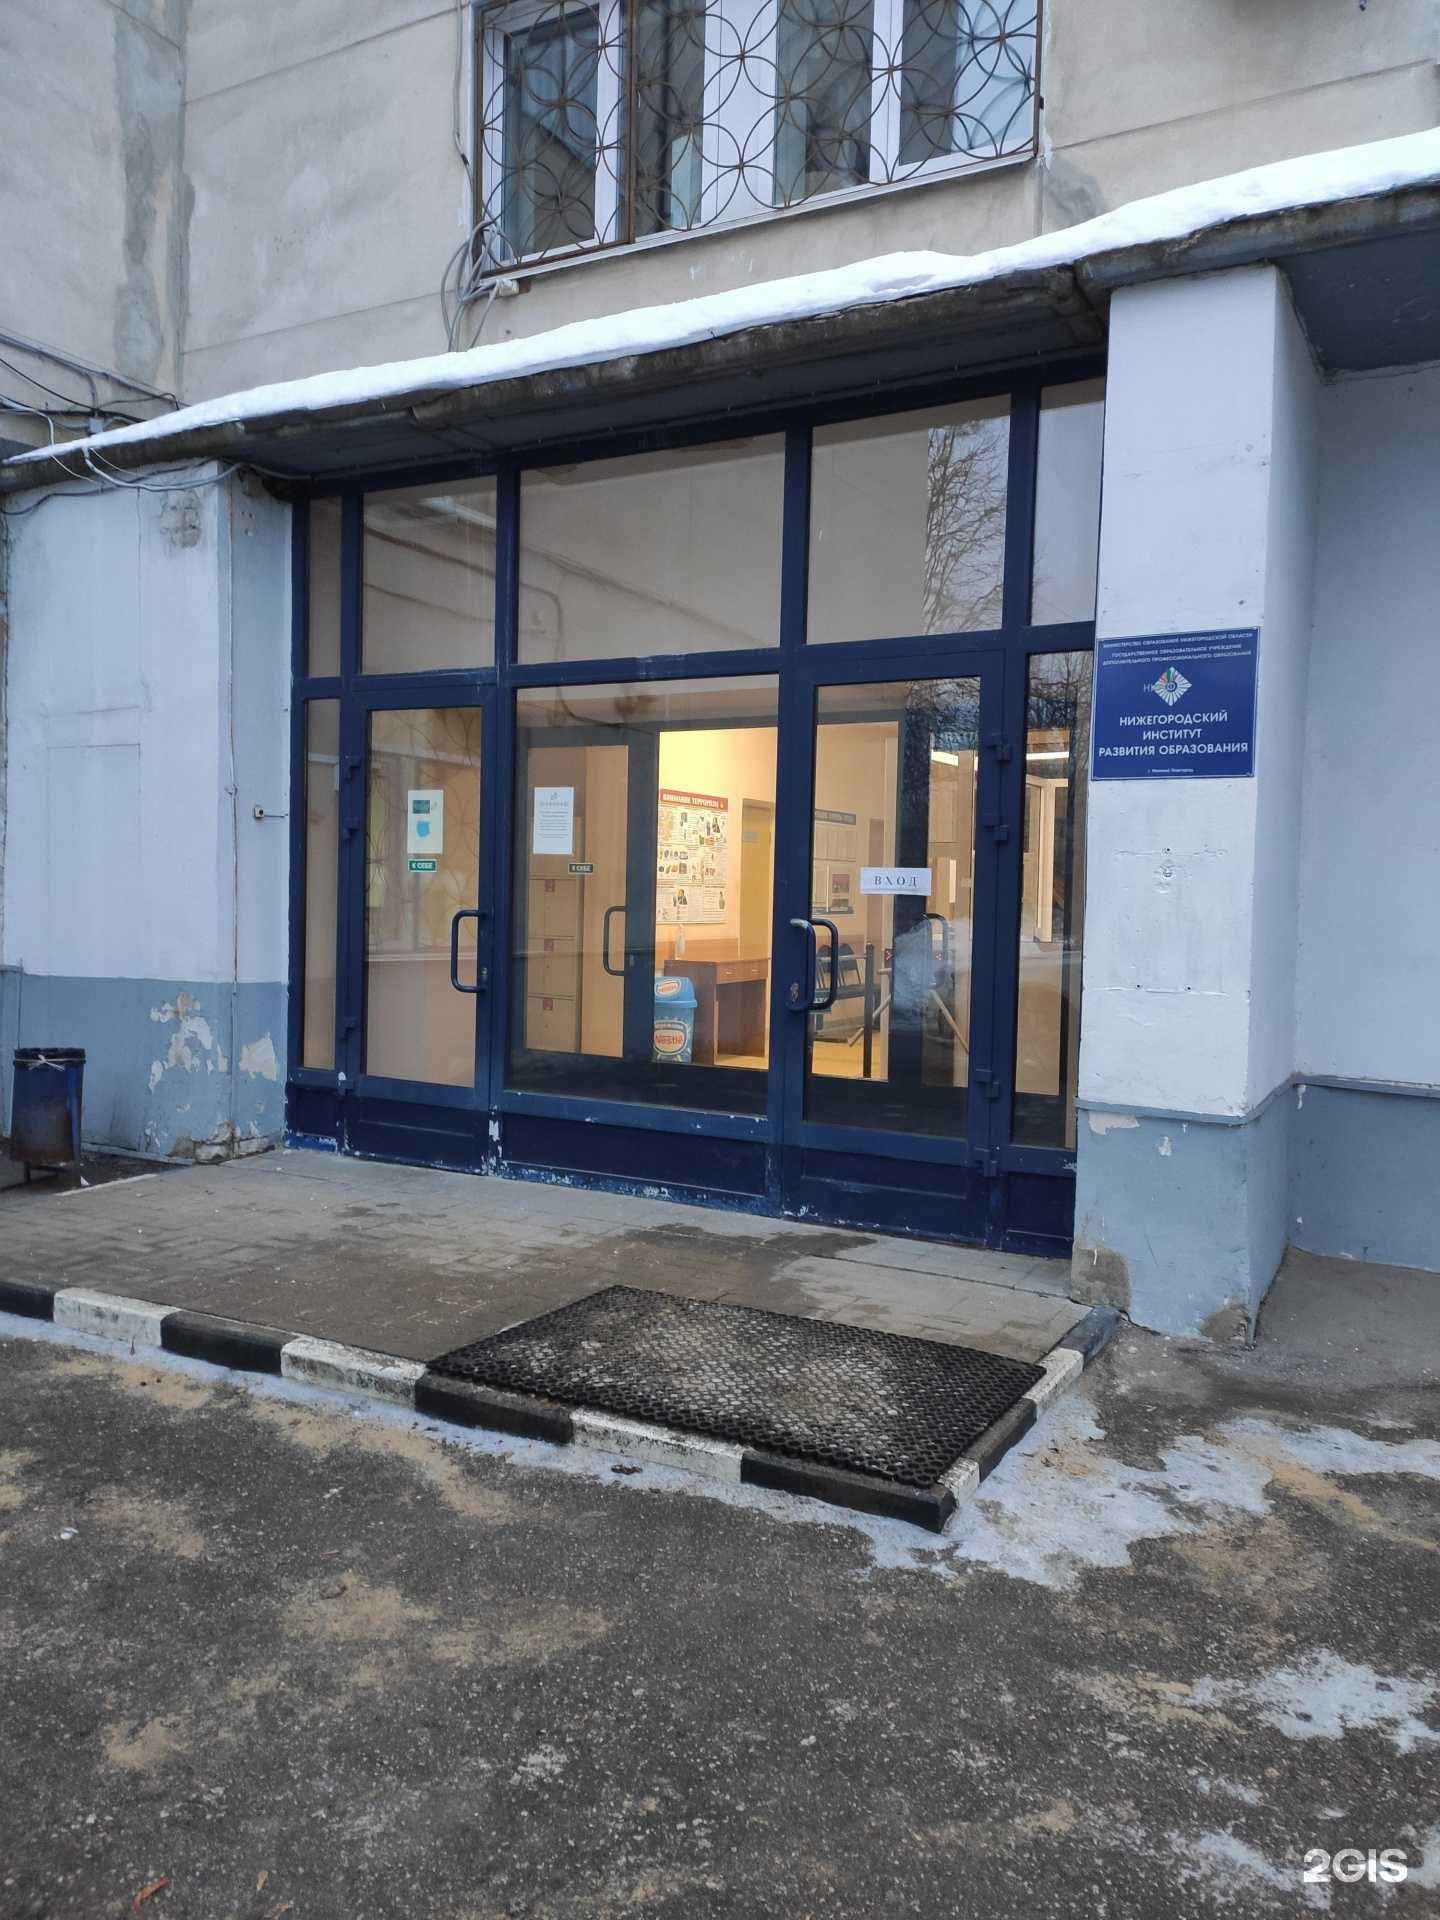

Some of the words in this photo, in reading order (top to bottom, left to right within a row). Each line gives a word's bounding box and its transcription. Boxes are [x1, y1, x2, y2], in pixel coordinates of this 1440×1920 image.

[1119, 709, 1229, 726] НИЖЕГОРОДСКИЙ
[1142, 728, 1203, 740] ИНСТИТУТ
[1098, 745, 1155, 757] РАЗВИТИЯ
[1158, 742, 1249, 755] ОБРАЗОВАНИЯ
[874, 875, 918, 887] ВХОД
